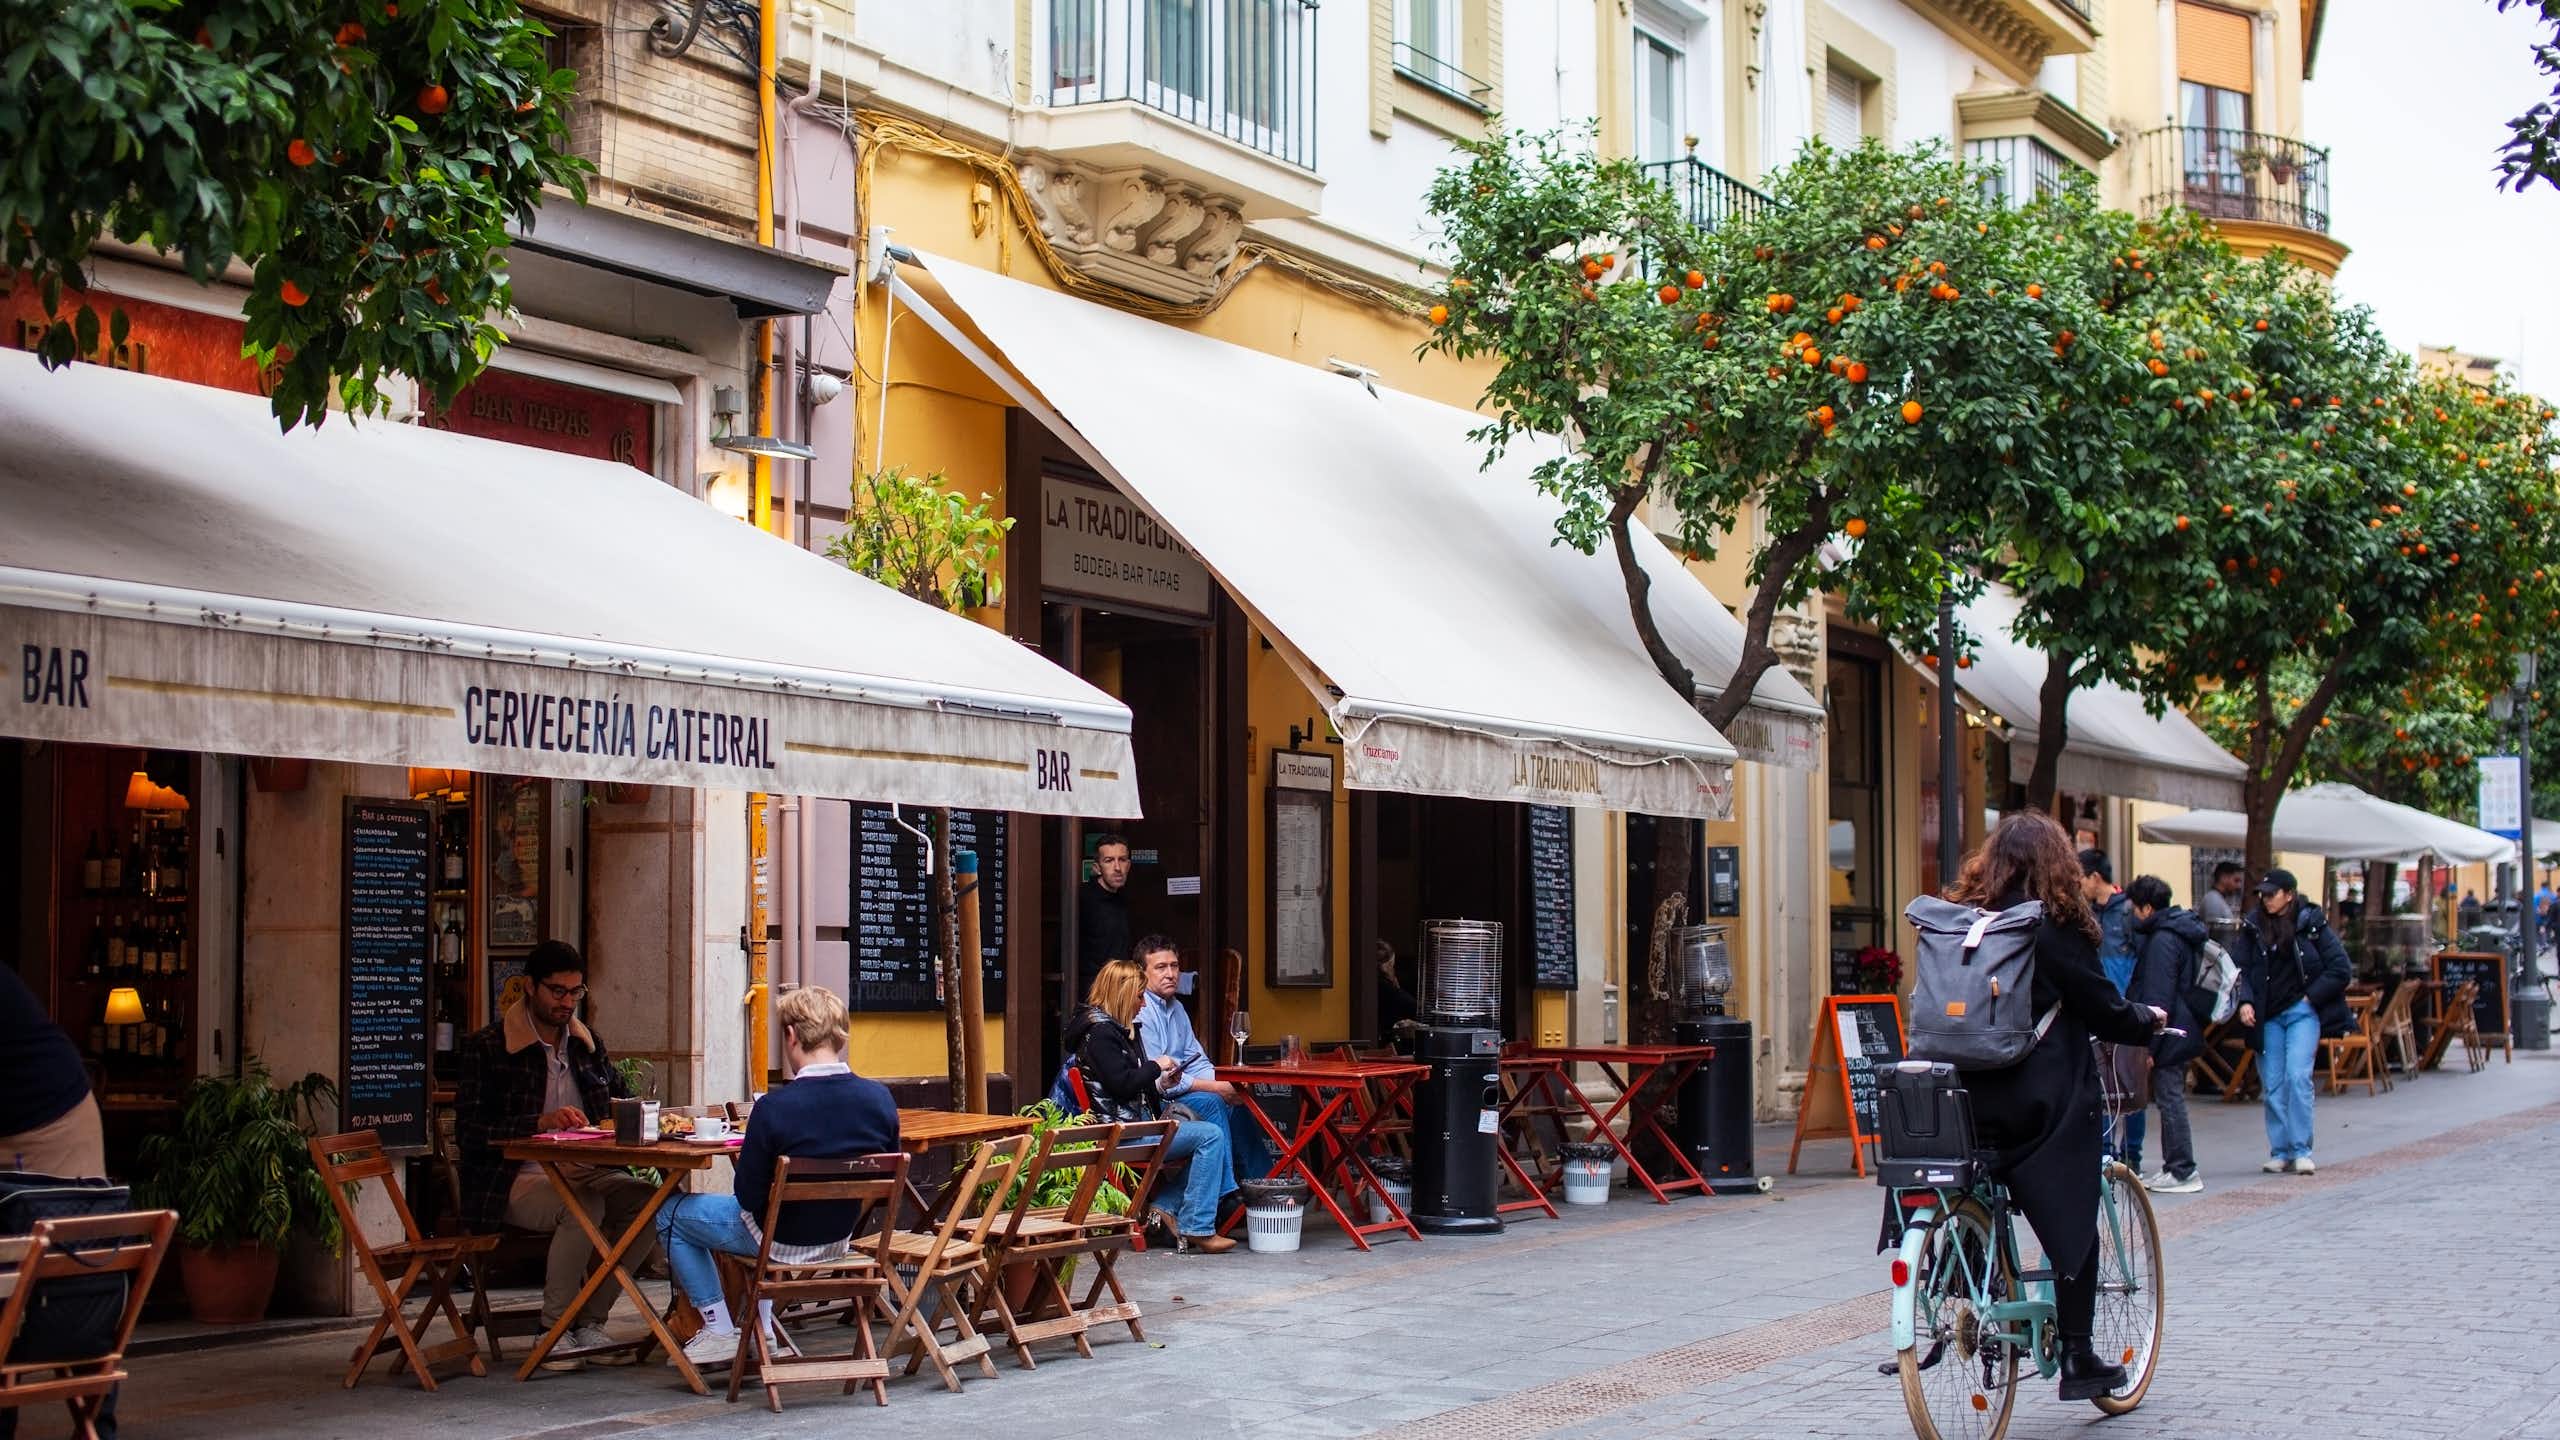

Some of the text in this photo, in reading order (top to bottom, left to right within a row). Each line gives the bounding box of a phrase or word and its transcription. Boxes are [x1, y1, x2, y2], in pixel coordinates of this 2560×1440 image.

[472, 394, 592, 437] BAR TAPAS
[1046, 490, 1187, 554] LA TRADICIO
[1074, 554, 1180, 592] BODEGA BAR TAPAS
[22, 644, 89, 708] BAR
[466, 686, 776, 770] CERVECERÍA CATEDRAL
[1037, 749, 1072, 792] BAR
[1279, 762, 1329, 778] LA TRADICIONAL
[1363, 744, 1399, 763] Cruzcampo
[1514, 753, 1602, 795] LA TRADICIONAL
[368, 1115, 381, 1125] IVA
